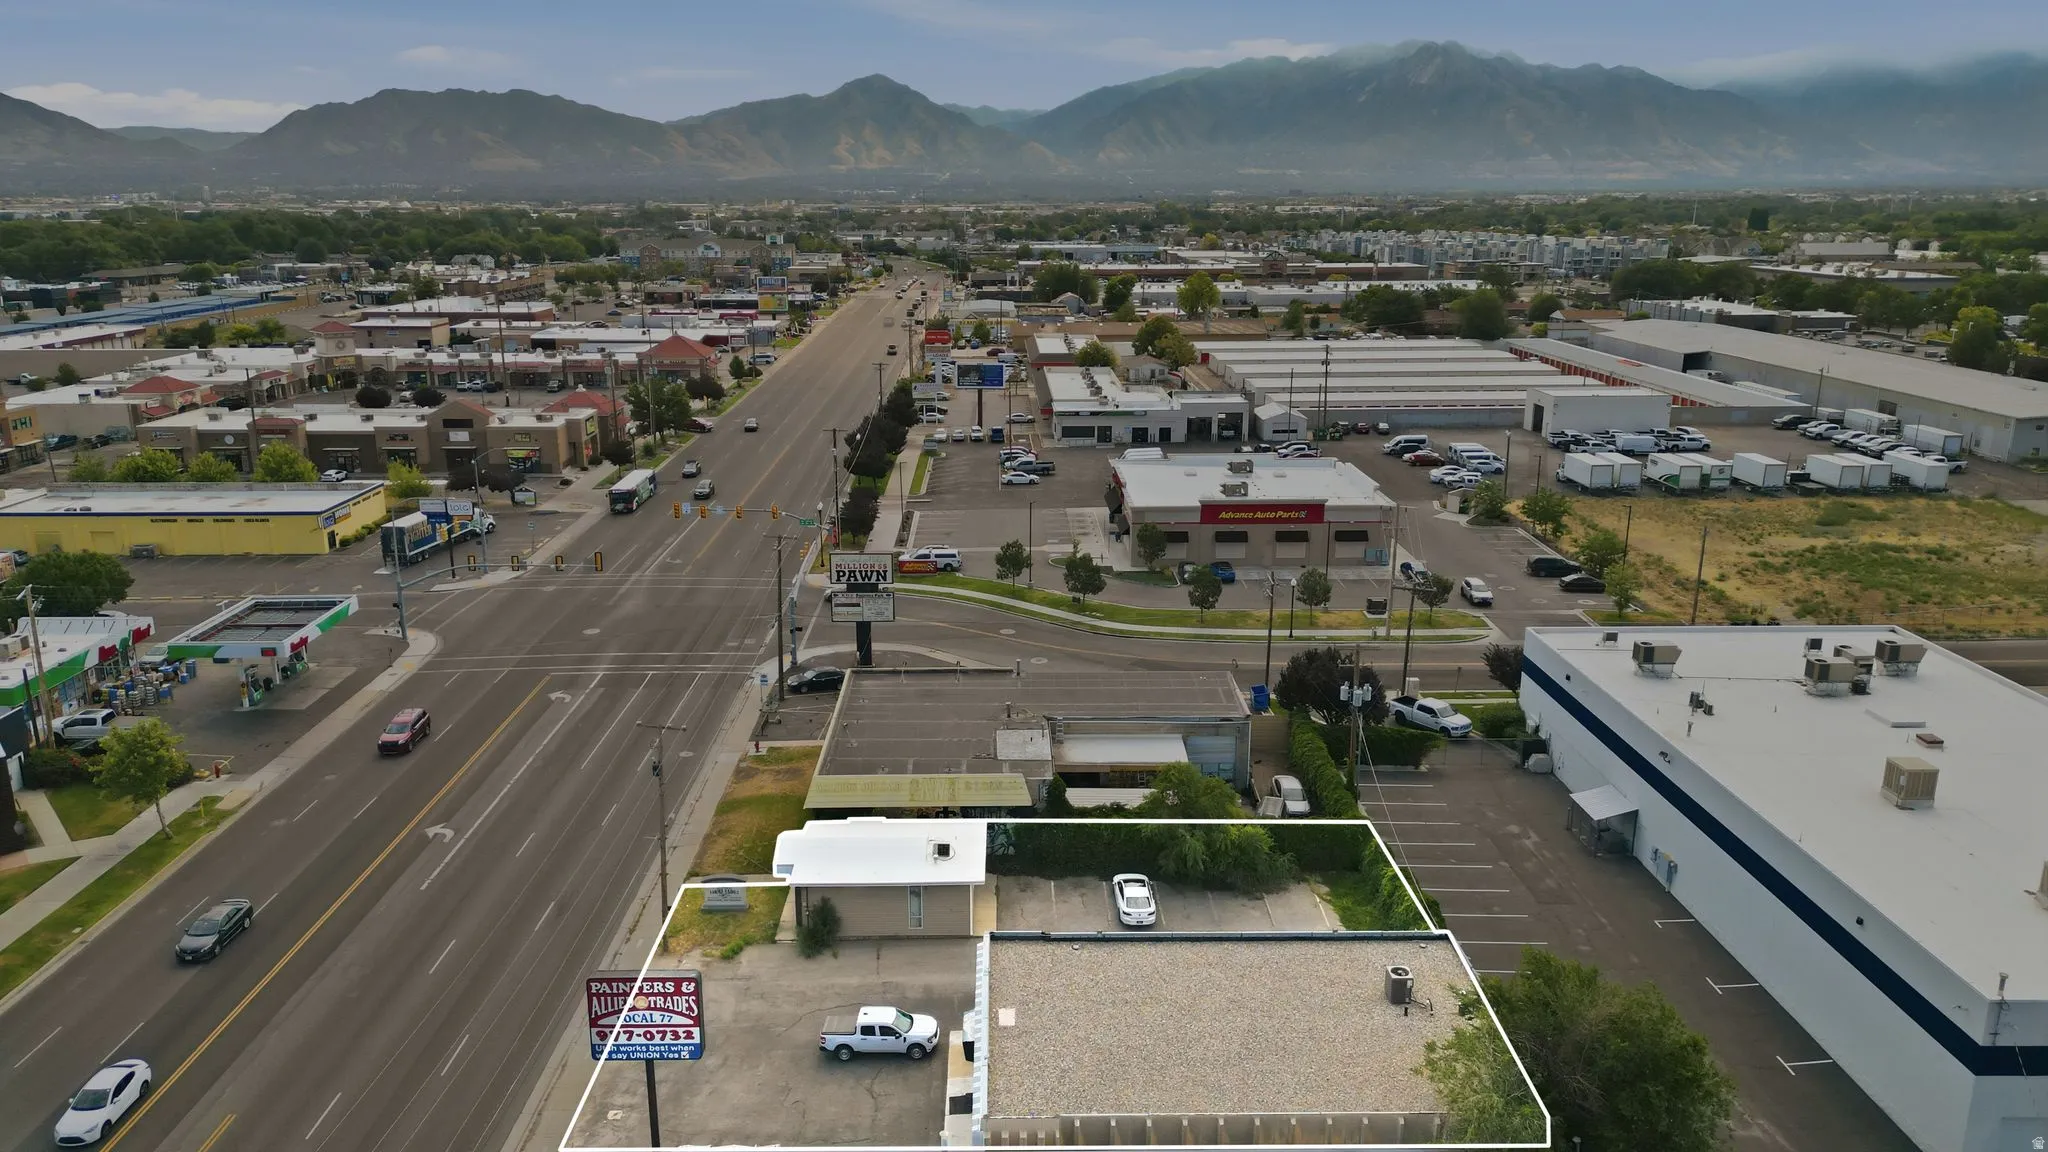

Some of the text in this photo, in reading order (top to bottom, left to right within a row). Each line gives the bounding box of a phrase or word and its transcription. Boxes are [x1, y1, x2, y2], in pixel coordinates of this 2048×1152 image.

[1218, 510, 1299, 519] Advance Auto Parts
[835, 570, 888, 582] PAWN
[680, 982, 696, 993] &
[648, 996, 698, 1017] TRADES
[659, 1014, 673, 1024] 77
[595, 1029, 695, 1042] 977-0732
[596, 1044, 695, 1052] Uth works best when
